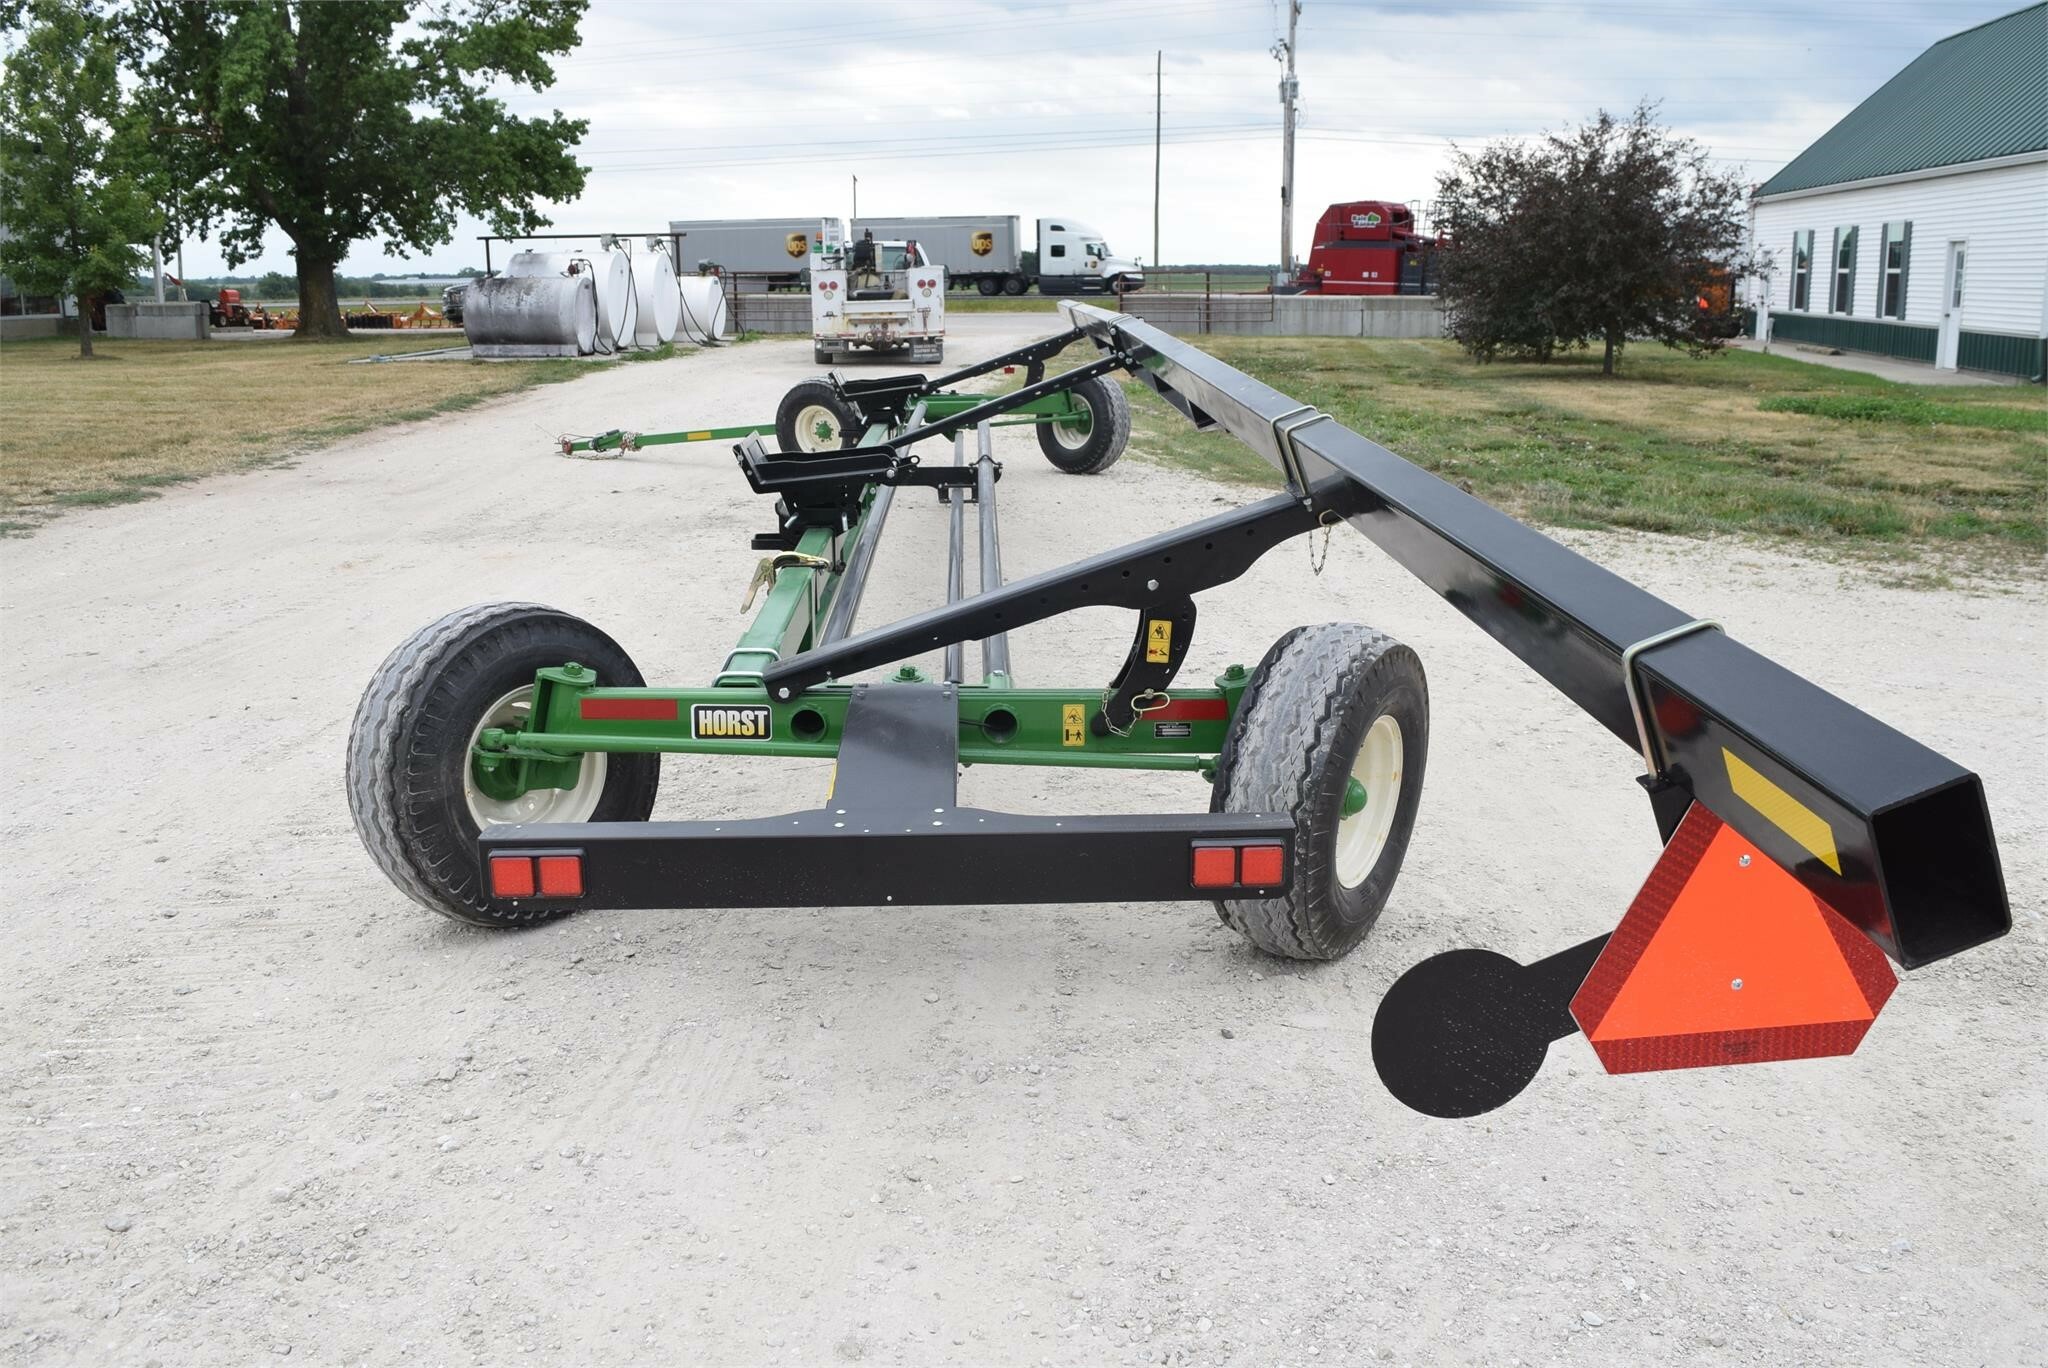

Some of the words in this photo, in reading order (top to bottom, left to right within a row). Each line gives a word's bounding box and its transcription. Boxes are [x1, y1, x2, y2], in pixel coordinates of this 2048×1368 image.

[788, 240, 806, 255] ups
[972, 238, 992, 254] ups
[698, 710, 768, 736] HORST
